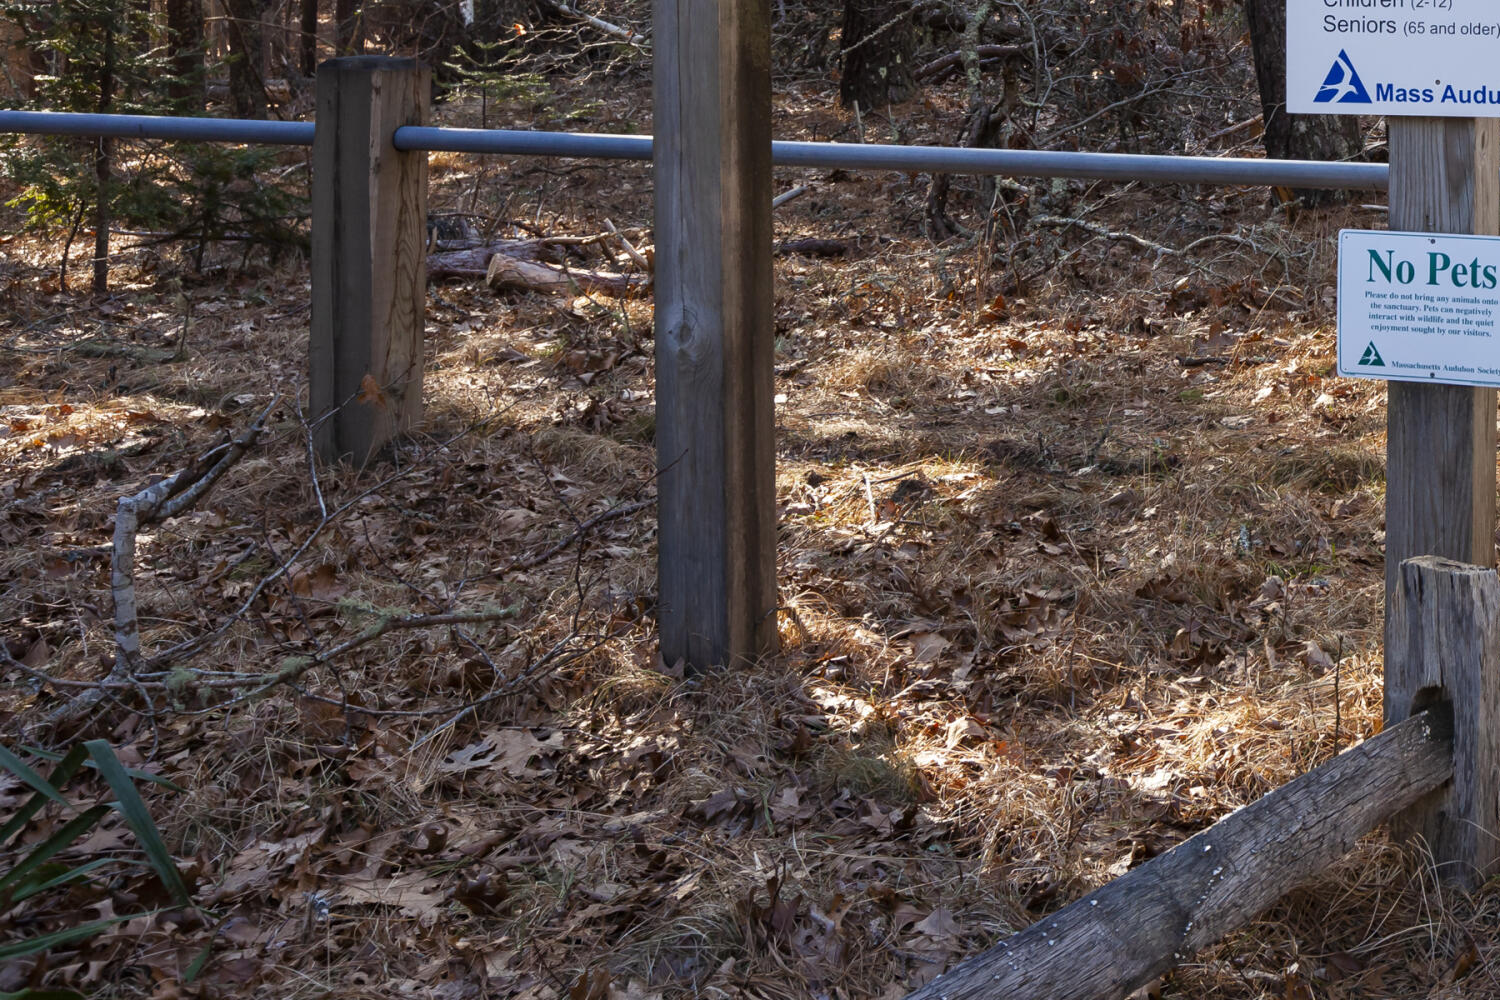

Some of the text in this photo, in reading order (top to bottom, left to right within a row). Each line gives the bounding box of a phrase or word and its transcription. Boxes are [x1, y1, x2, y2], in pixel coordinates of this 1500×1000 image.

[1323, 15, 1396, 34] Seniors
[1403, 21, 1425, 37] (65
[1430, 22, 1456, 35] and
[1460, 22, 1500, 39] older)
[1376, 83, 1434, 103] Mass
[1367, 249, 1497, 289] No Pets
[1365, 291, 1387, 299] Please
[1415, 293, 1435, 302] bring
[1436, 295, 1449, 303] any
[1452, 296, 1480, 304] animals
[1455, 308, 1492, 316] negatively
[1369, 312, 1397, 320] interact
[1417, 315, 1444, 323] wildlife
[1446, 316, 1459, 324] and
[1475, 318, 1494, 327] quiet
[1371, 324, 1409, 332] enjoyment
[1411, 326, 1435, 334] sought
[1437, 326, 1446, 335] by
[1463, 329, 1492, 337] visitors.
[1392, 361, 1441, 371] Massachusetts
[1443, 365, 1475, 373] Audubon
